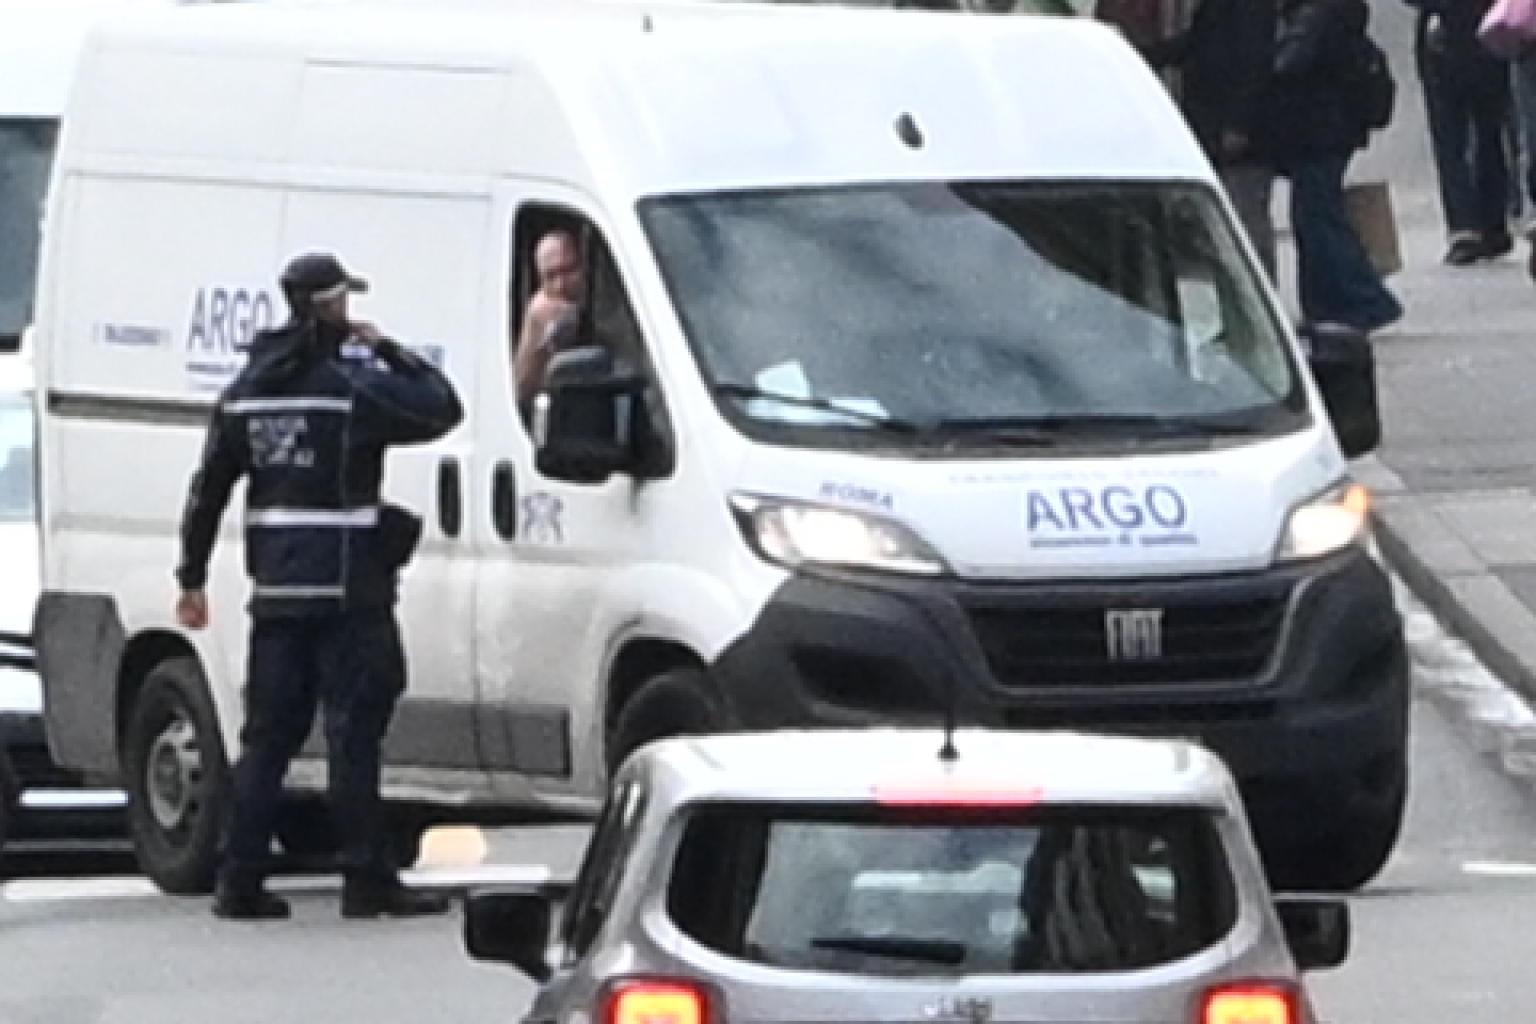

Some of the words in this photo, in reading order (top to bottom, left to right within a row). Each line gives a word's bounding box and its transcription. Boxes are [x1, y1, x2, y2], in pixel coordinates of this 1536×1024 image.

[186, 287, 273, 353] ARGO
[1026, 484, 1188, 532] ARGO
[1106, 608, 1162, 661] FIAT
